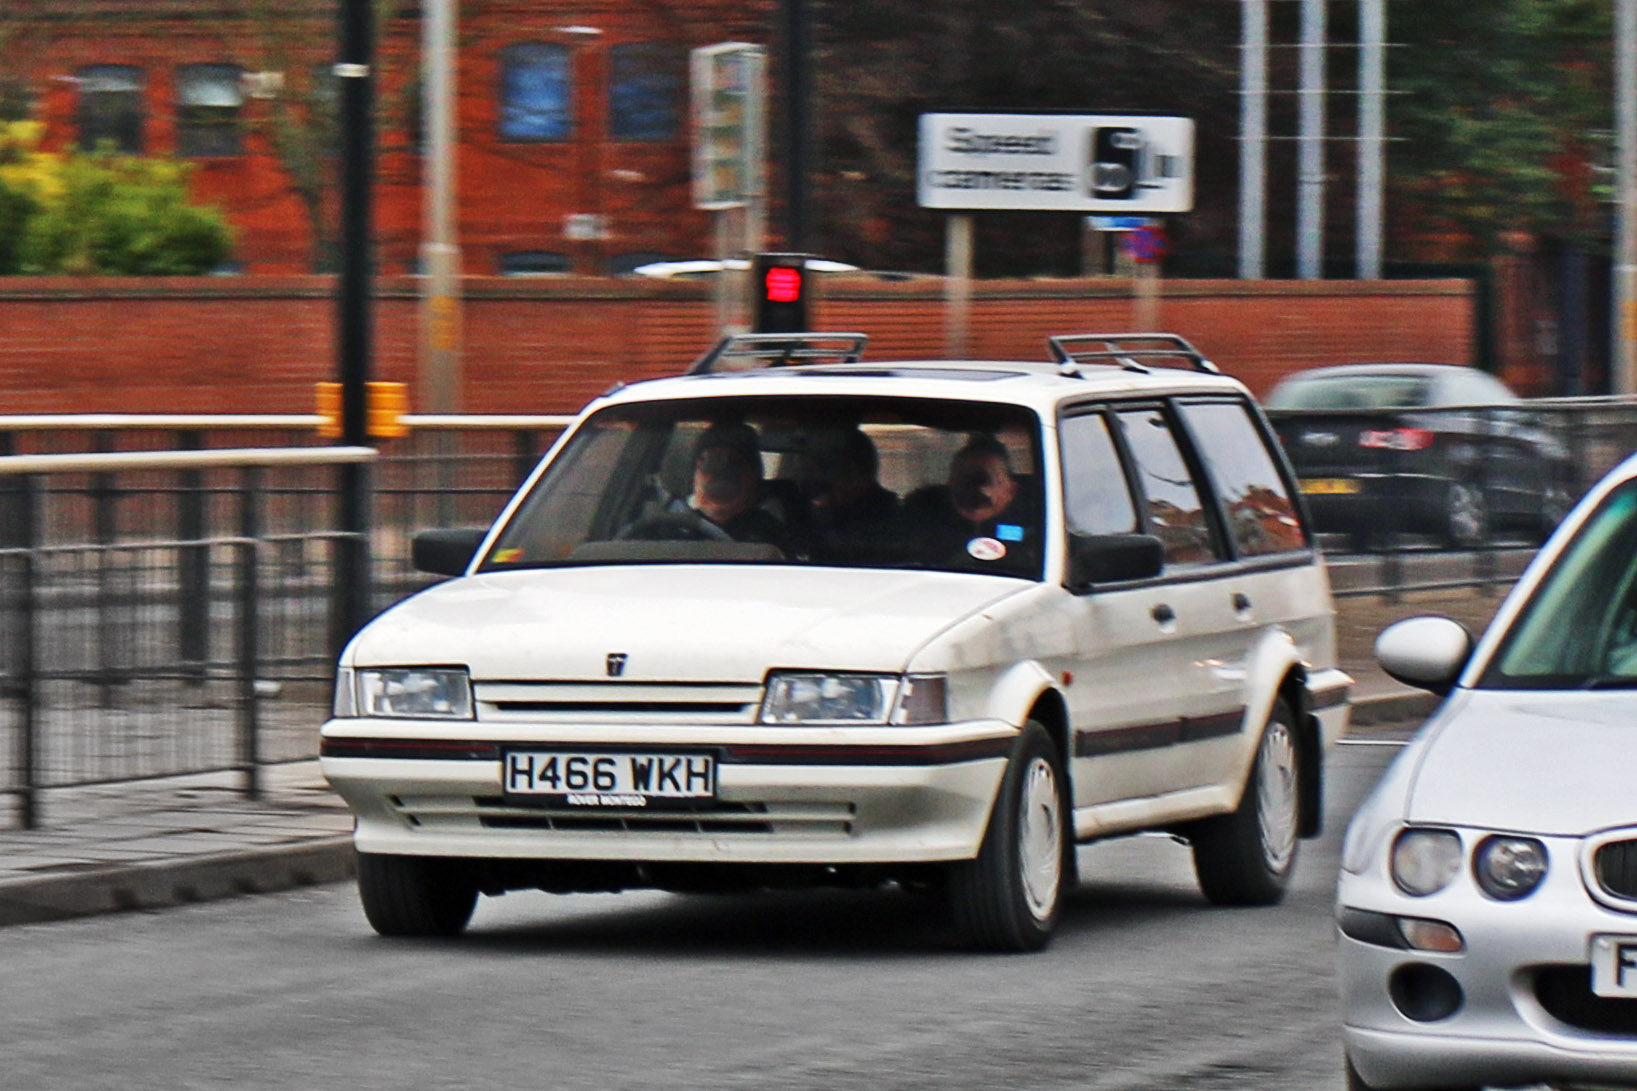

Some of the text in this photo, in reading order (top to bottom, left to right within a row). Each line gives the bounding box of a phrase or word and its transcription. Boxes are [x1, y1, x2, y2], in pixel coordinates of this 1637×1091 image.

[947, 127, 1058, 157] Speed
[927, 170, 1075, 191] cameras
[510, 755, 710, 792] H466 WKH
